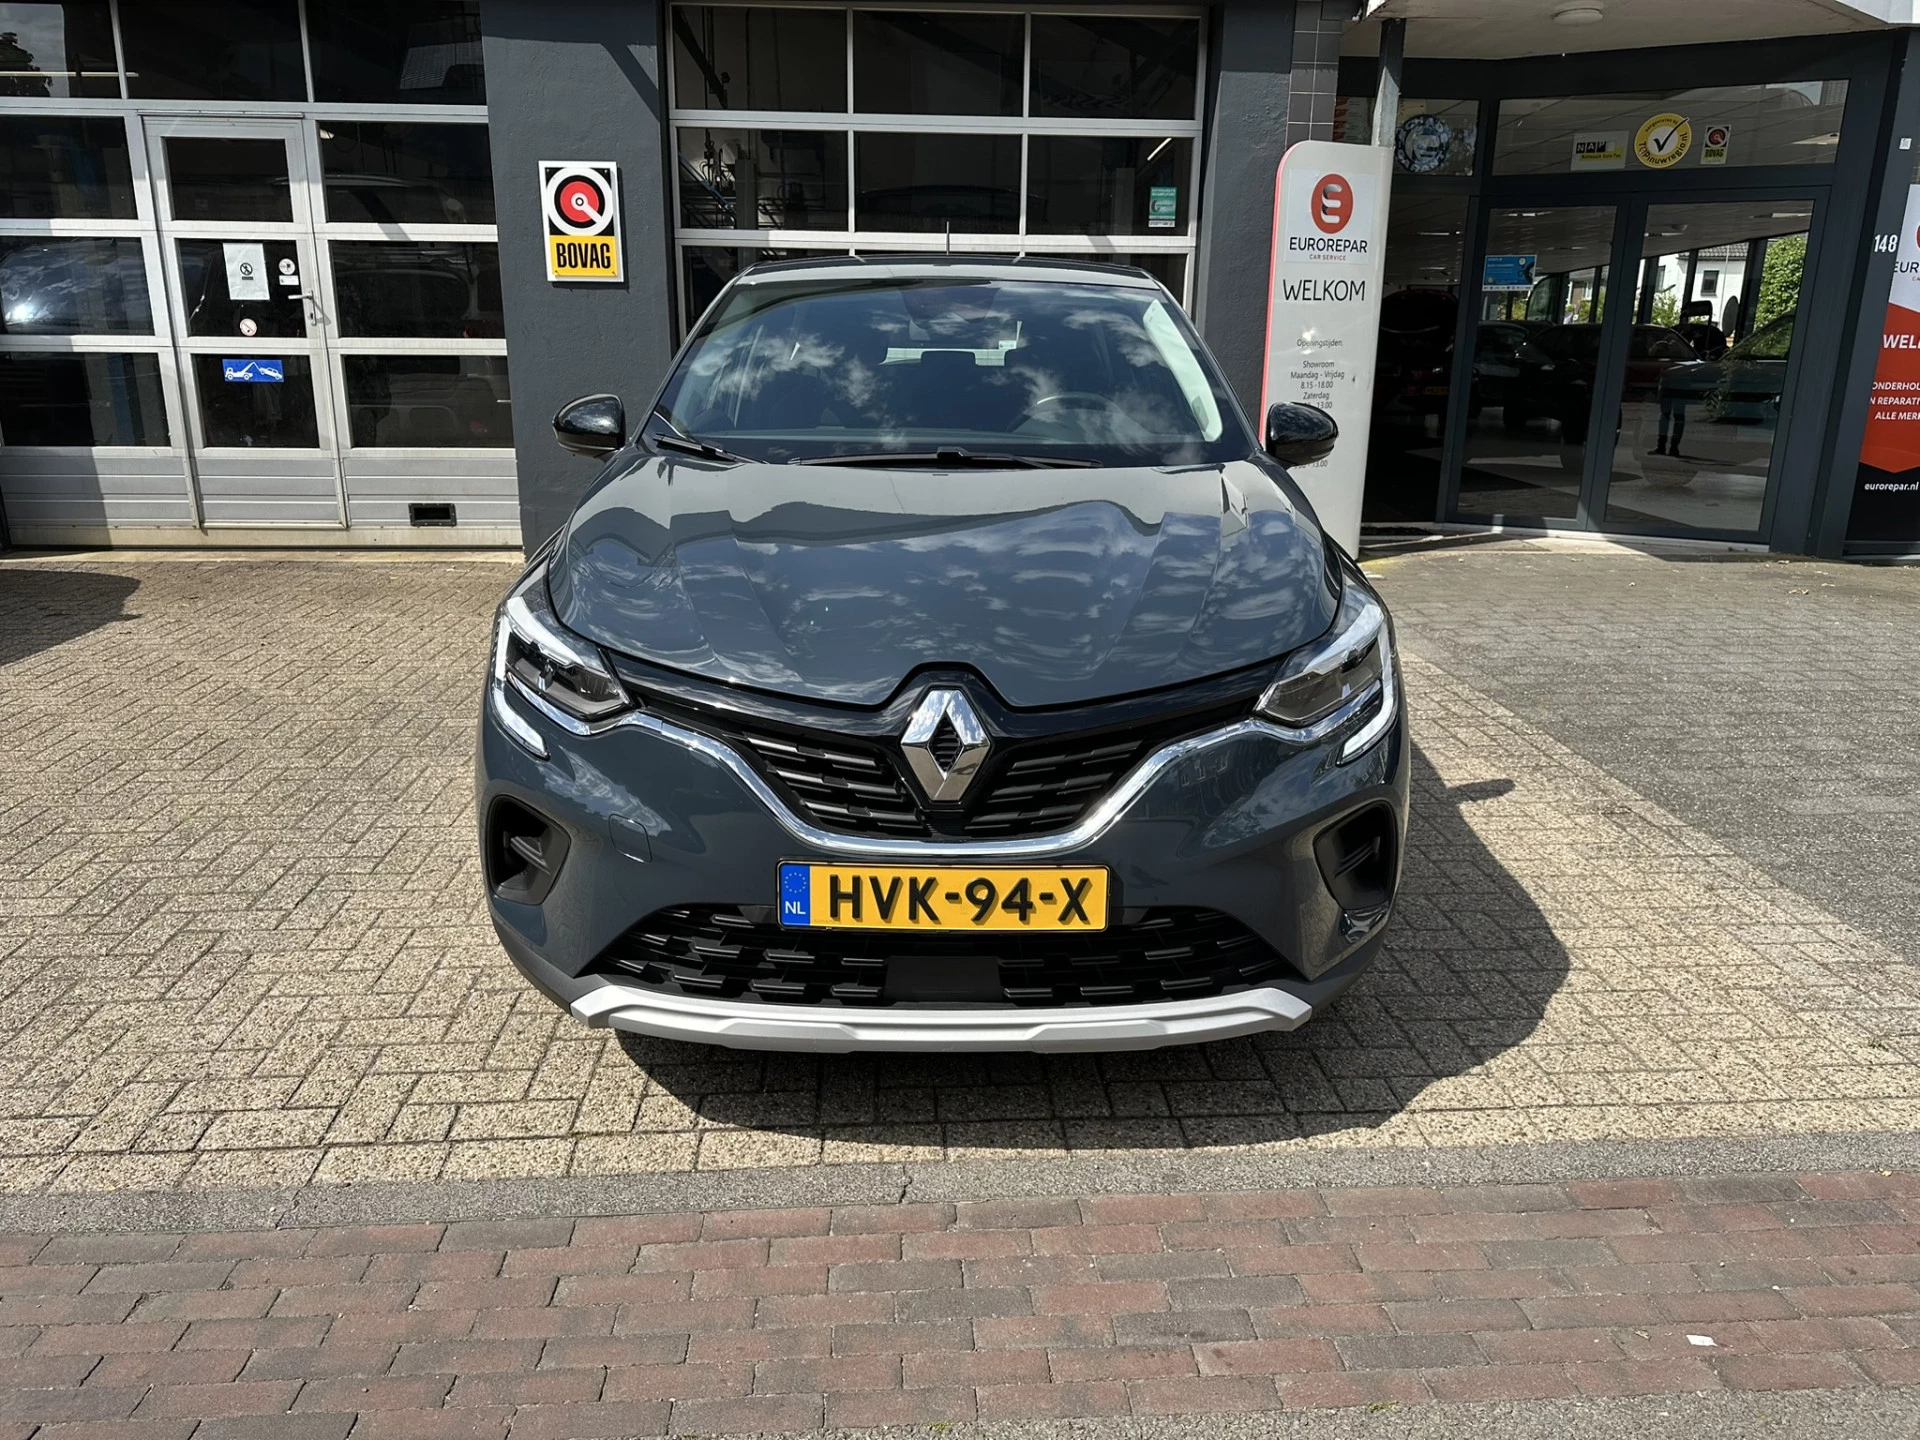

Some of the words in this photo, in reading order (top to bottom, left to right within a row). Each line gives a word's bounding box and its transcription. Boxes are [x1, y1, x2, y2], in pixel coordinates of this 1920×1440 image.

[1704, 149, 1724, 158] BOVAG
[1289, 237, 1368, 253] EUROREPAR
[1874, 234, 1898, 253] 148
[556, 242, 611, 269] BOVAG
[1283, 279, 1366, 301] WELKOM
[1302, 360, 1335, 368] Showroom
[1290, 371, 1319, 379] Maandag
[1324, 371, 1345, 379] Vrijdag
[1300, 381, 1314, 389] 8.15
[1302, 392, 1330, 400] Zaterdag
[1317, 401, 1333, 409] 13.00
[1874, 411, 1897, 420] ALLE
[1864, 481, 1920, 493] eurorepar.nl
[829, 874, 1092, 923] HVK-94-X
[785, 901, 806, 914] NL
